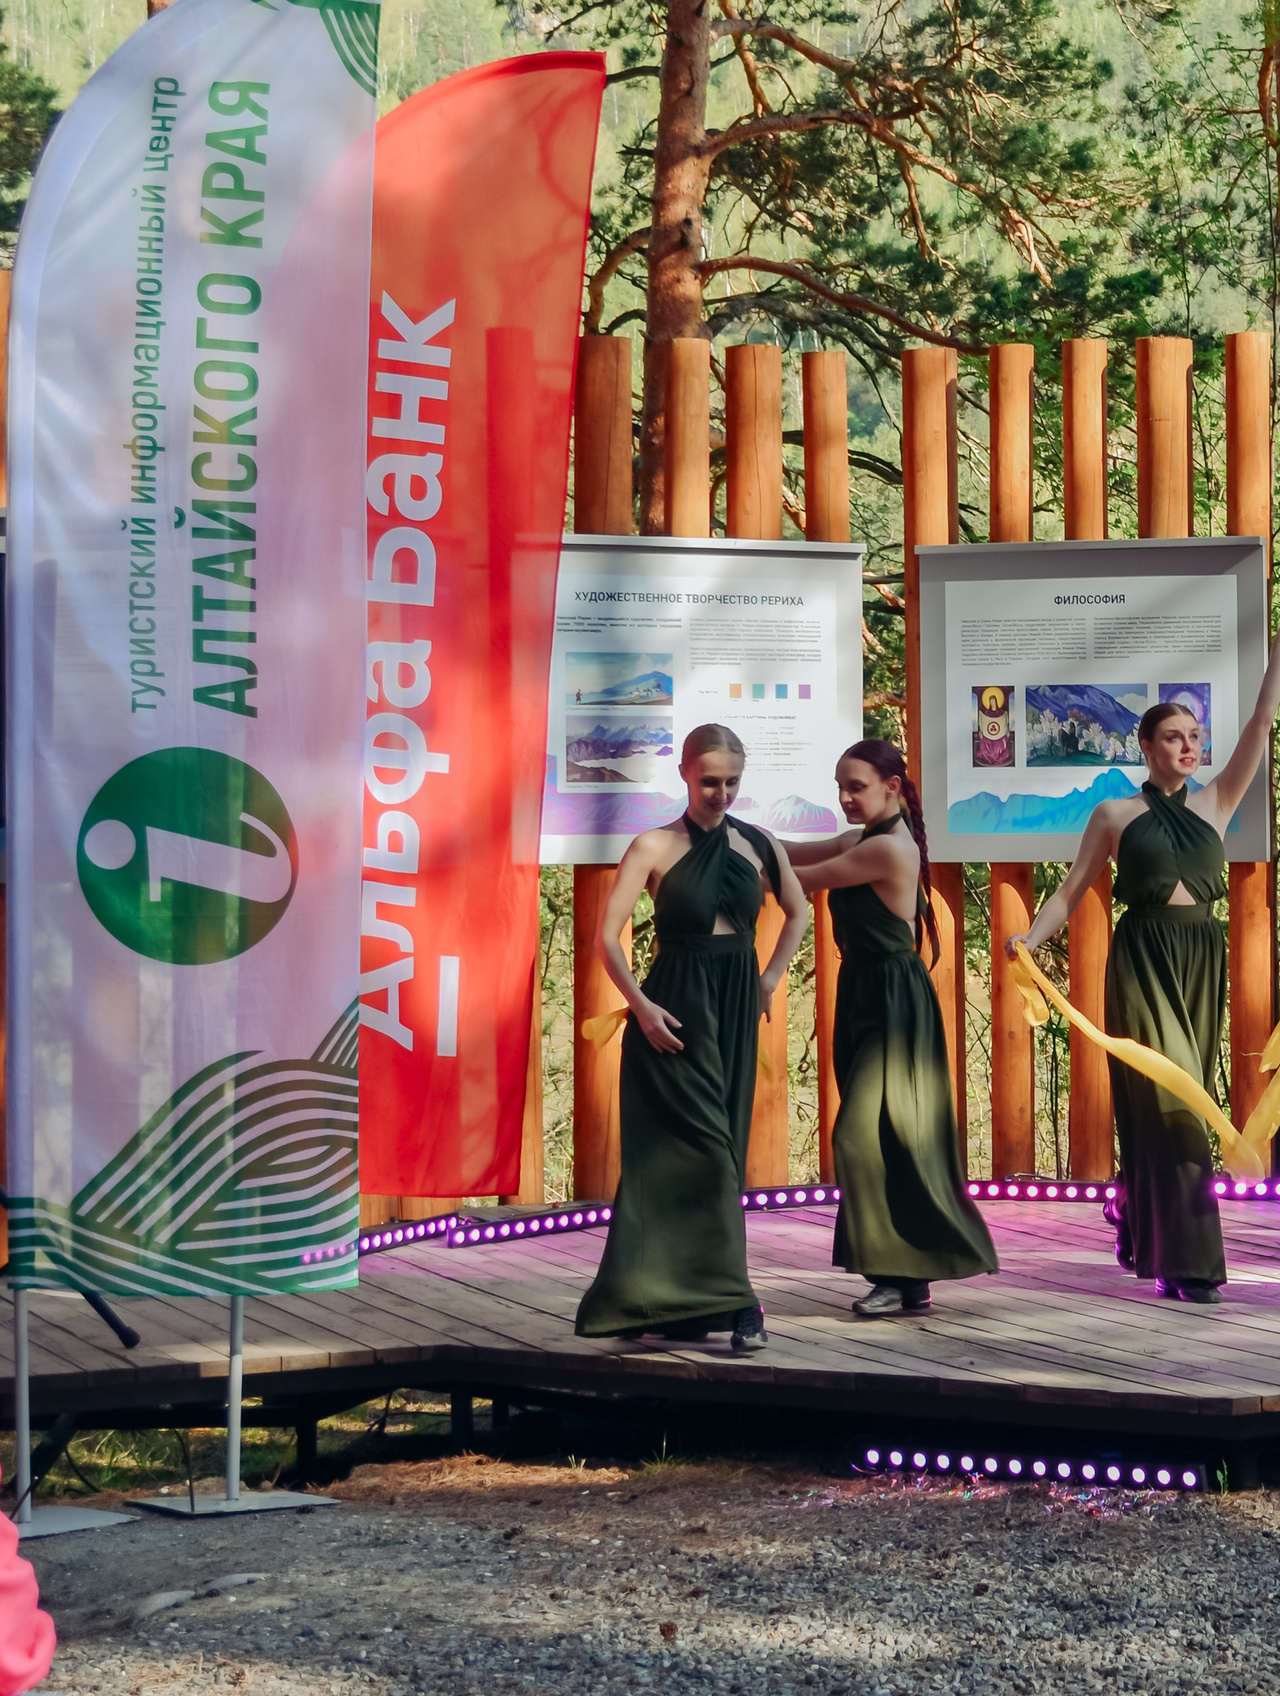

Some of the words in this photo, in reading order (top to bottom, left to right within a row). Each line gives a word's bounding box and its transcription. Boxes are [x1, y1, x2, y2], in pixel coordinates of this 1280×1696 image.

[143, 76, 187, 174] центр
[199, 80, 271, 249] КРАЯ
[122, 182, 168, 504] информационный
[173, 272, 263, 719] АЛТАЙСКОГО
[121, 518, 166, 714] туристский
[574, 591, 683, 604] ХУДОЖЕСТВЕННОЕ
[685, 593, 758, 606] ТВОРЧЕСТВО
[761, 594, 804, 607] РЕРИХА
[1053, 594, 1126, 606] ФИЛОСОФИЯ
[359, 638, 450, 1052] Альфа
